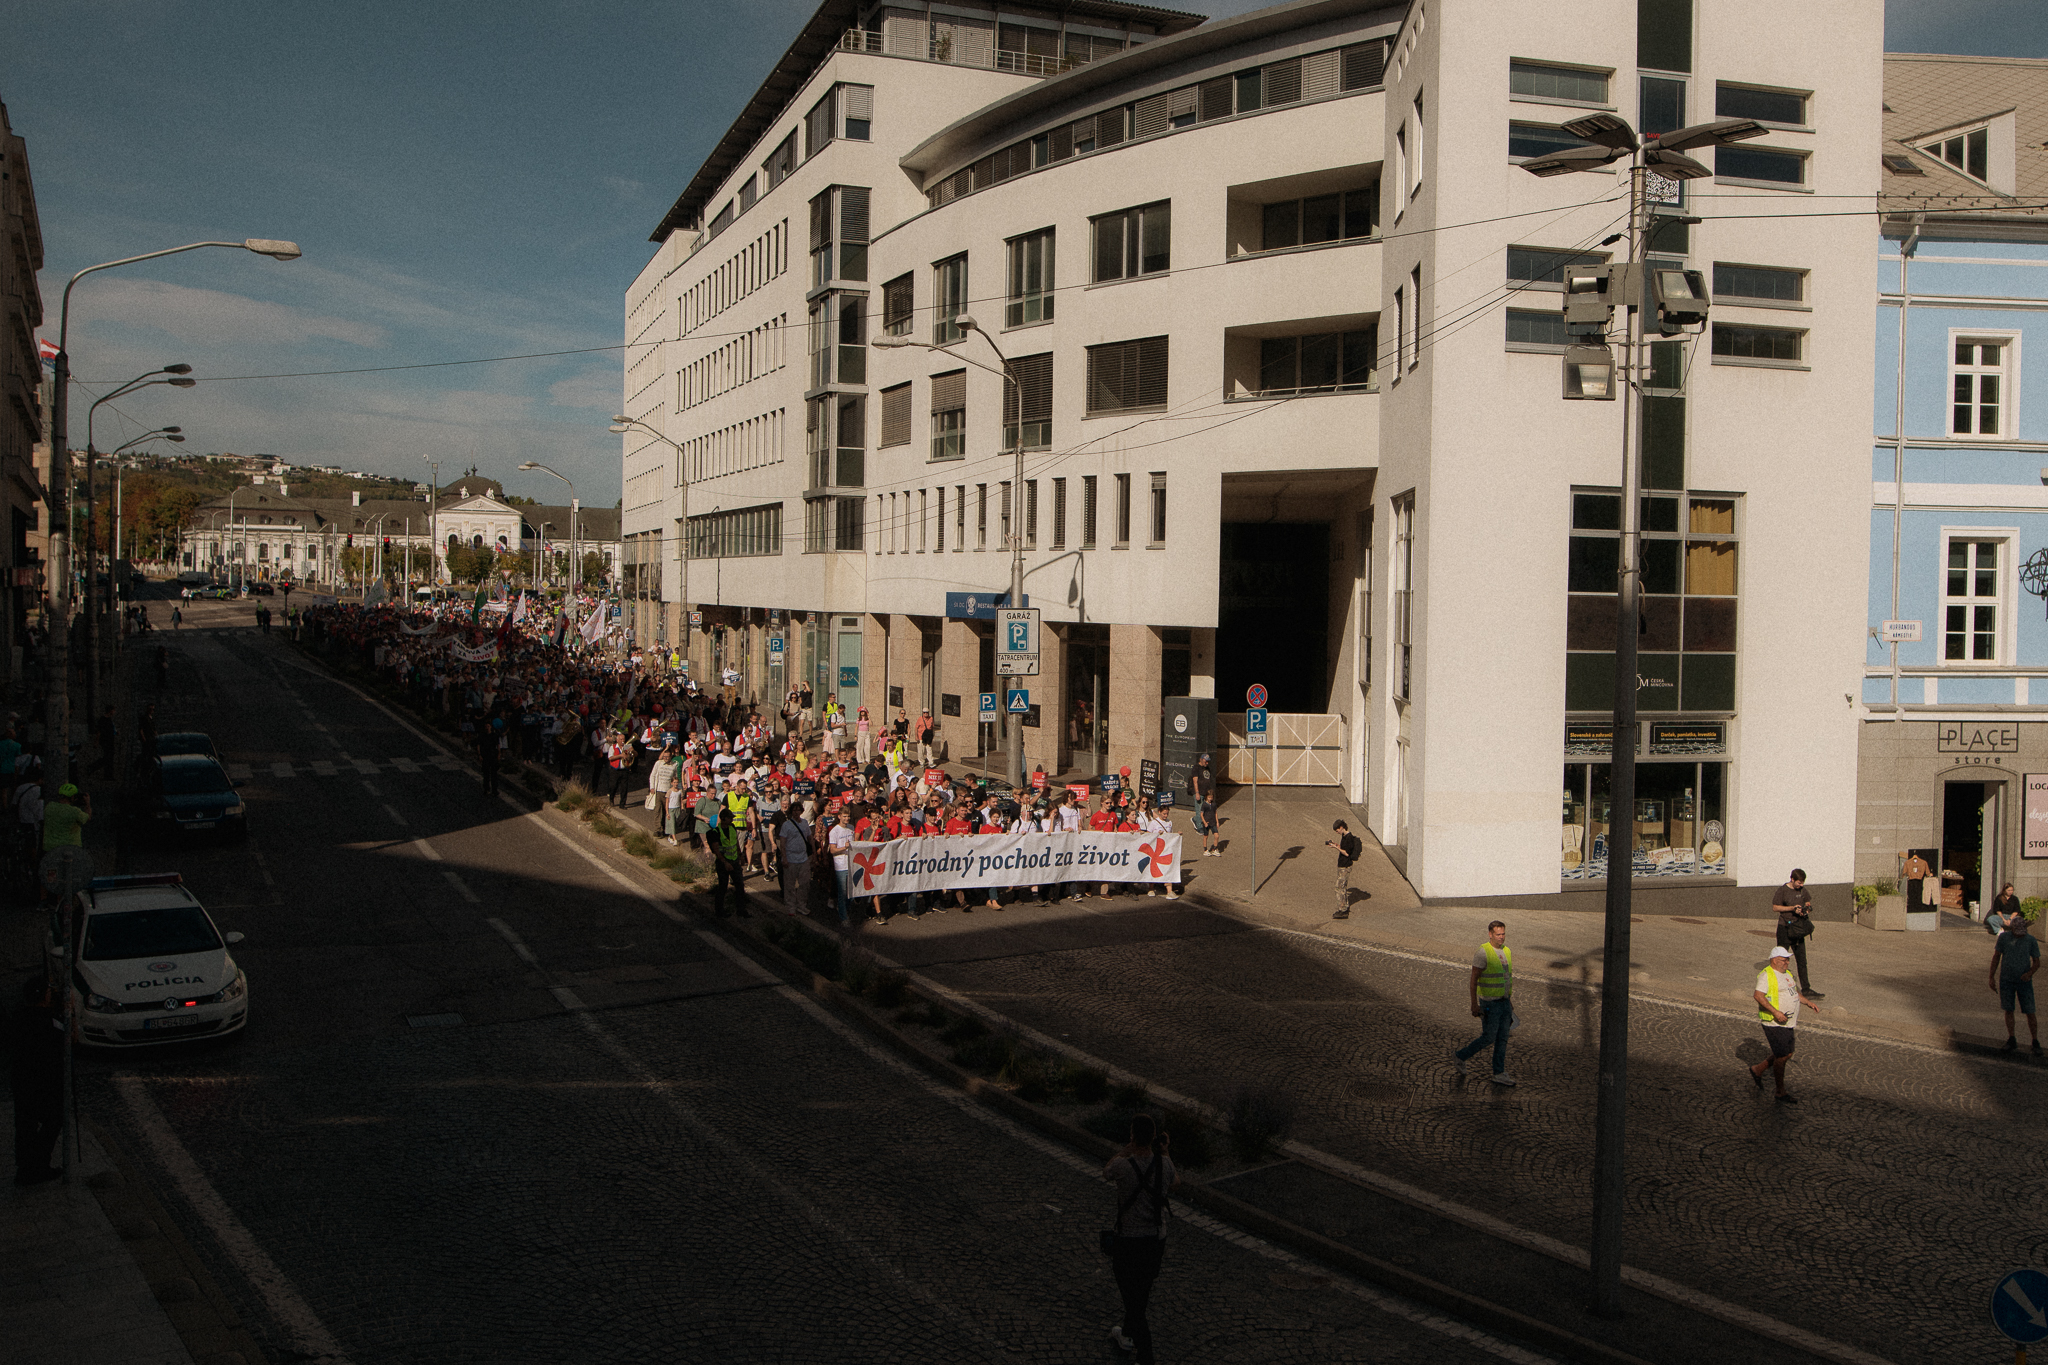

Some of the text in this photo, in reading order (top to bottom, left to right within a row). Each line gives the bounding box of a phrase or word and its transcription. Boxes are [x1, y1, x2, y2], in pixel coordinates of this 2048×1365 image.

[1006, 611, 1031, 620] GARÁŽ
[982, 695, 992, 710] P
[1250, 711, 1262, 730] P
[1947, 726, 2011, 751] PLACE
[1955, 755, 2001, 764] store
[892, 844, 1130, 878] národný pochod za život
